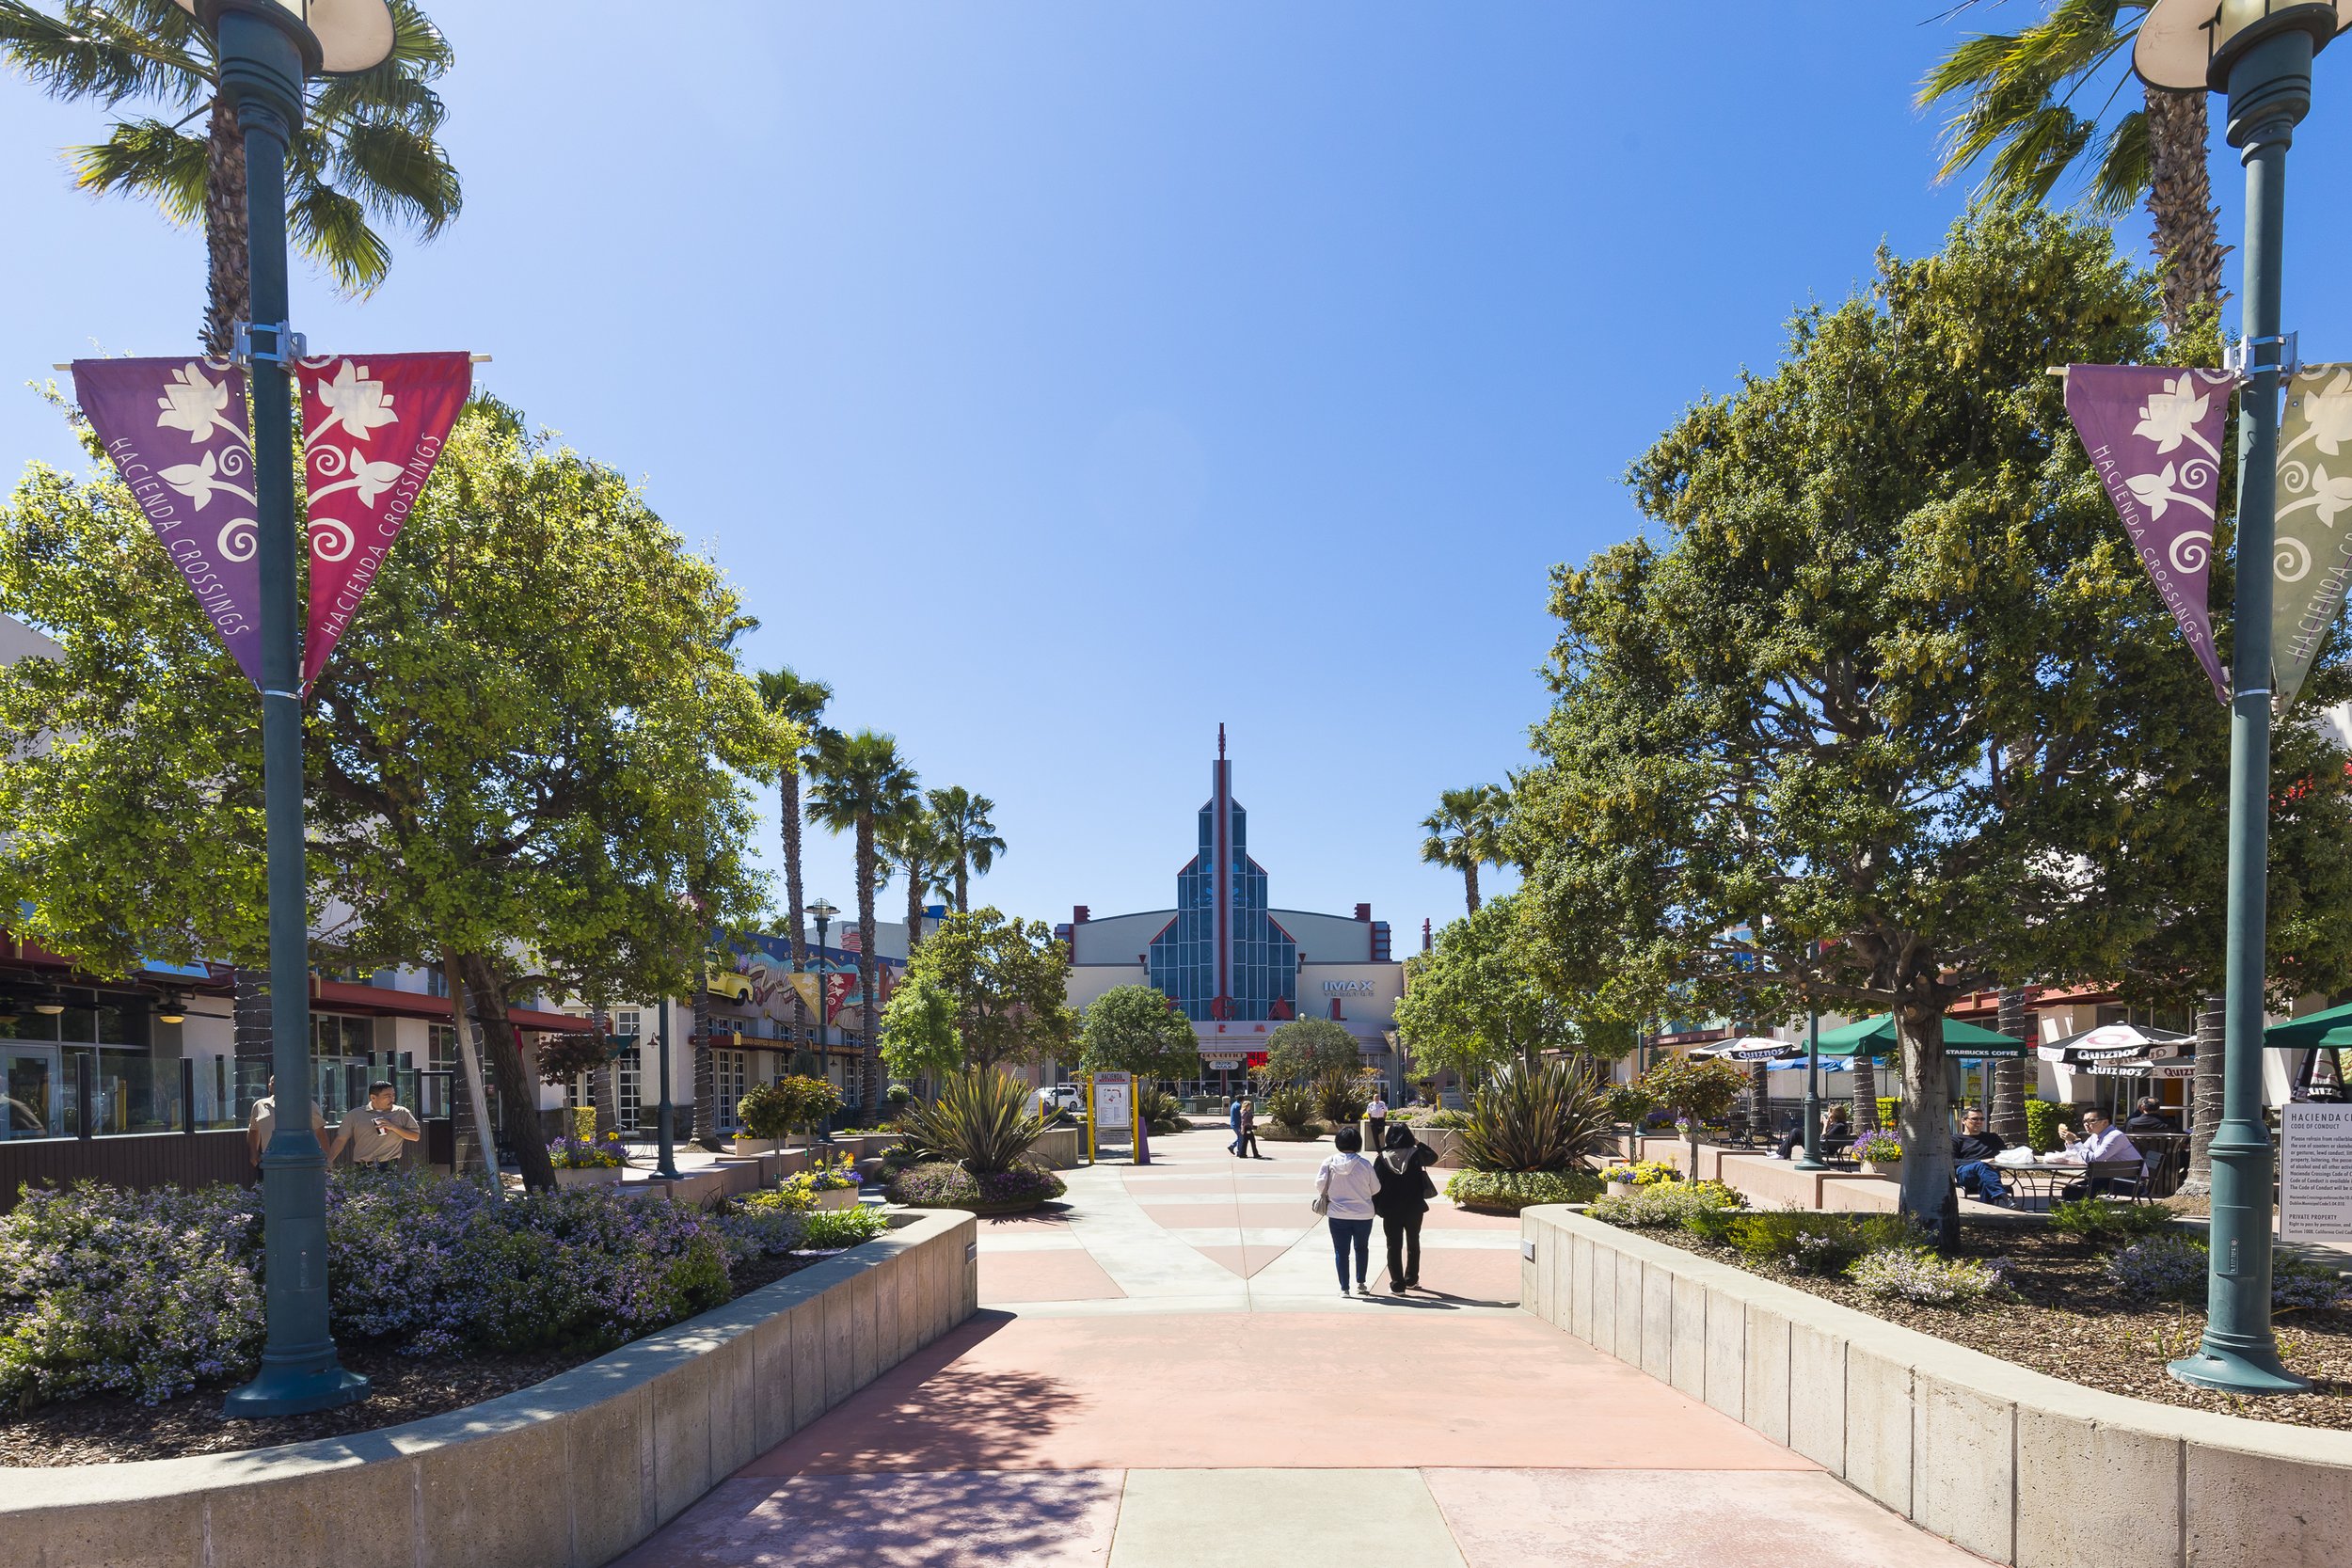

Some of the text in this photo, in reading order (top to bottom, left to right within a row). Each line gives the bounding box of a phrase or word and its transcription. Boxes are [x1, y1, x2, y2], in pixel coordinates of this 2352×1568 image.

[108, 437, 249, 637] HACIENDA CROSSINGS
[321, 431, 441, 638] HACIENDA CROSSINGS
[2092, 444, 2203, 643] HACIENDA CROSSINGS
[2285, 566, 2349, 659] HACIENDA
[1324, 981, 1375, 990] IMAX
[1738, 1048, 1785, 1060] Quiznos
[2077, 1047, 2141, 1060] Quiznos
[2086, 1064, 2145, 1077] Quiznos
[2344, 1114, 2352, 1122] C
